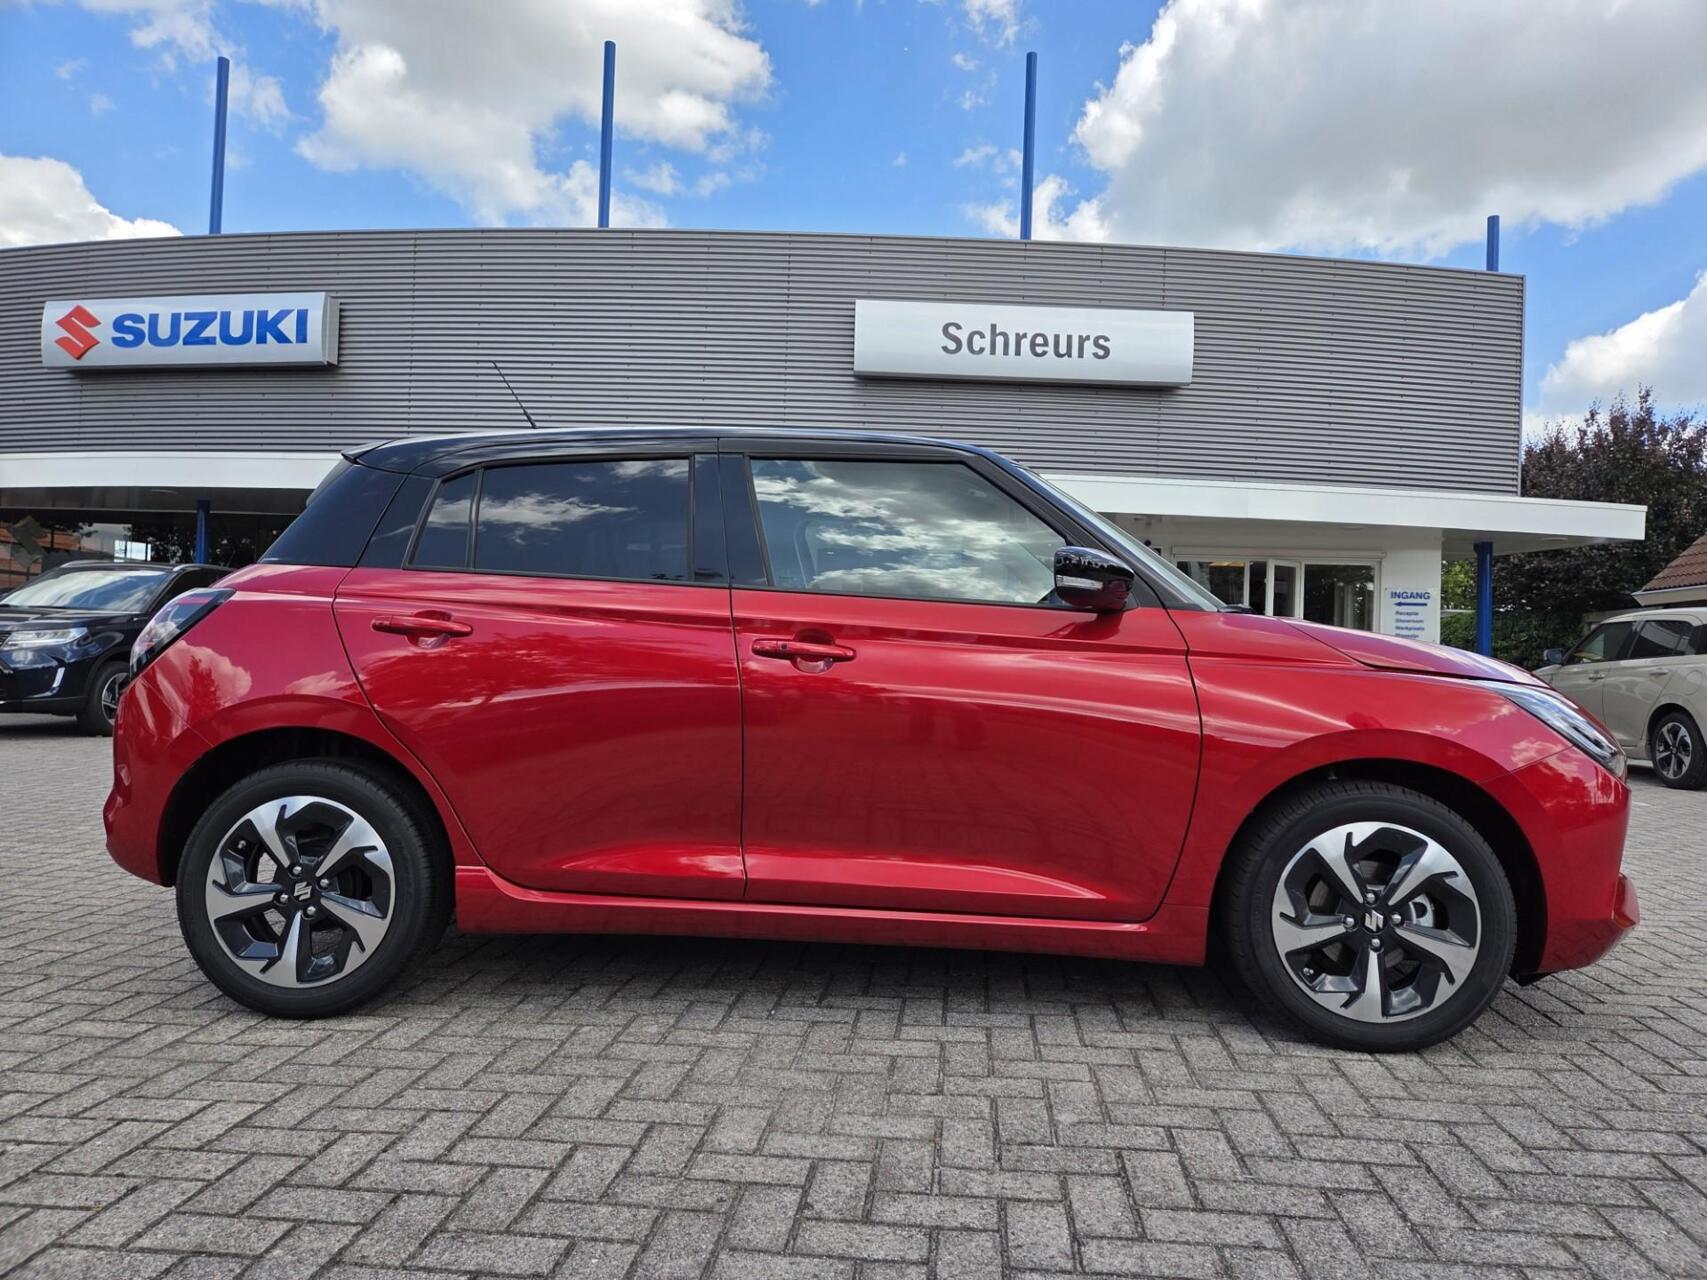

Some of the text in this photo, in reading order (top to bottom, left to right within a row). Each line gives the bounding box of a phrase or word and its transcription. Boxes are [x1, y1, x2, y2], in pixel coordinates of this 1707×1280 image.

[111, 308, 308, 348] SUZUKI
[941, 322, 1112, 360] Schreurs
[1390, 591, 1431, 600] INGANG
